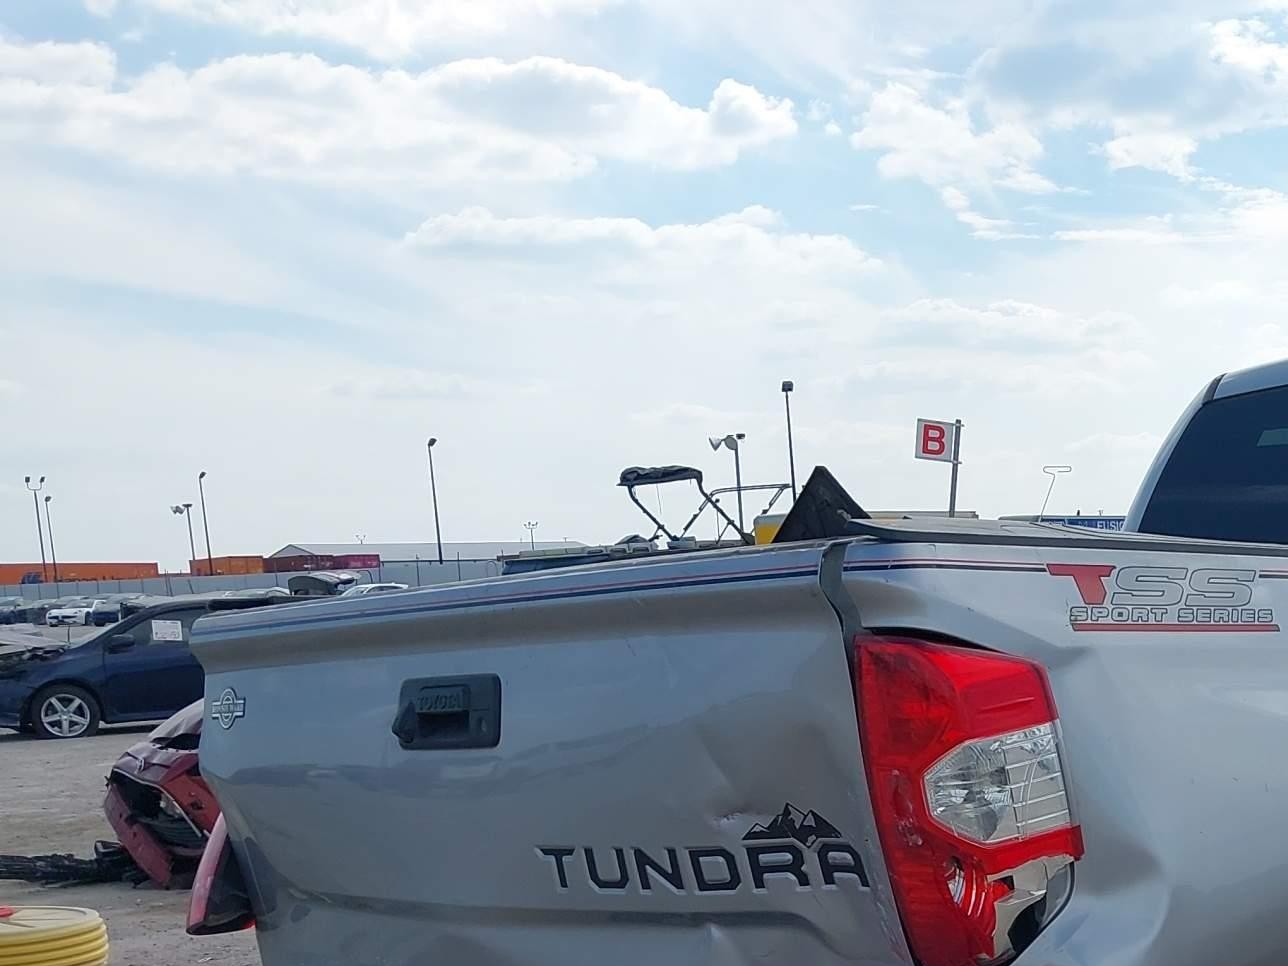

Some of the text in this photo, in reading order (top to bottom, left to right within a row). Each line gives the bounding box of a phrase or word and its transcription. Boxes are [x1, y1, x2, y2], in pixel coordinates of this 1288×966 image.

[922, 423, 945, 456] B
[1045, 563, 1257, 608] TSS
[1069, 606, 1274, 624] SPORT SERIES
[535, 843, 872, 895] TUNDRA
